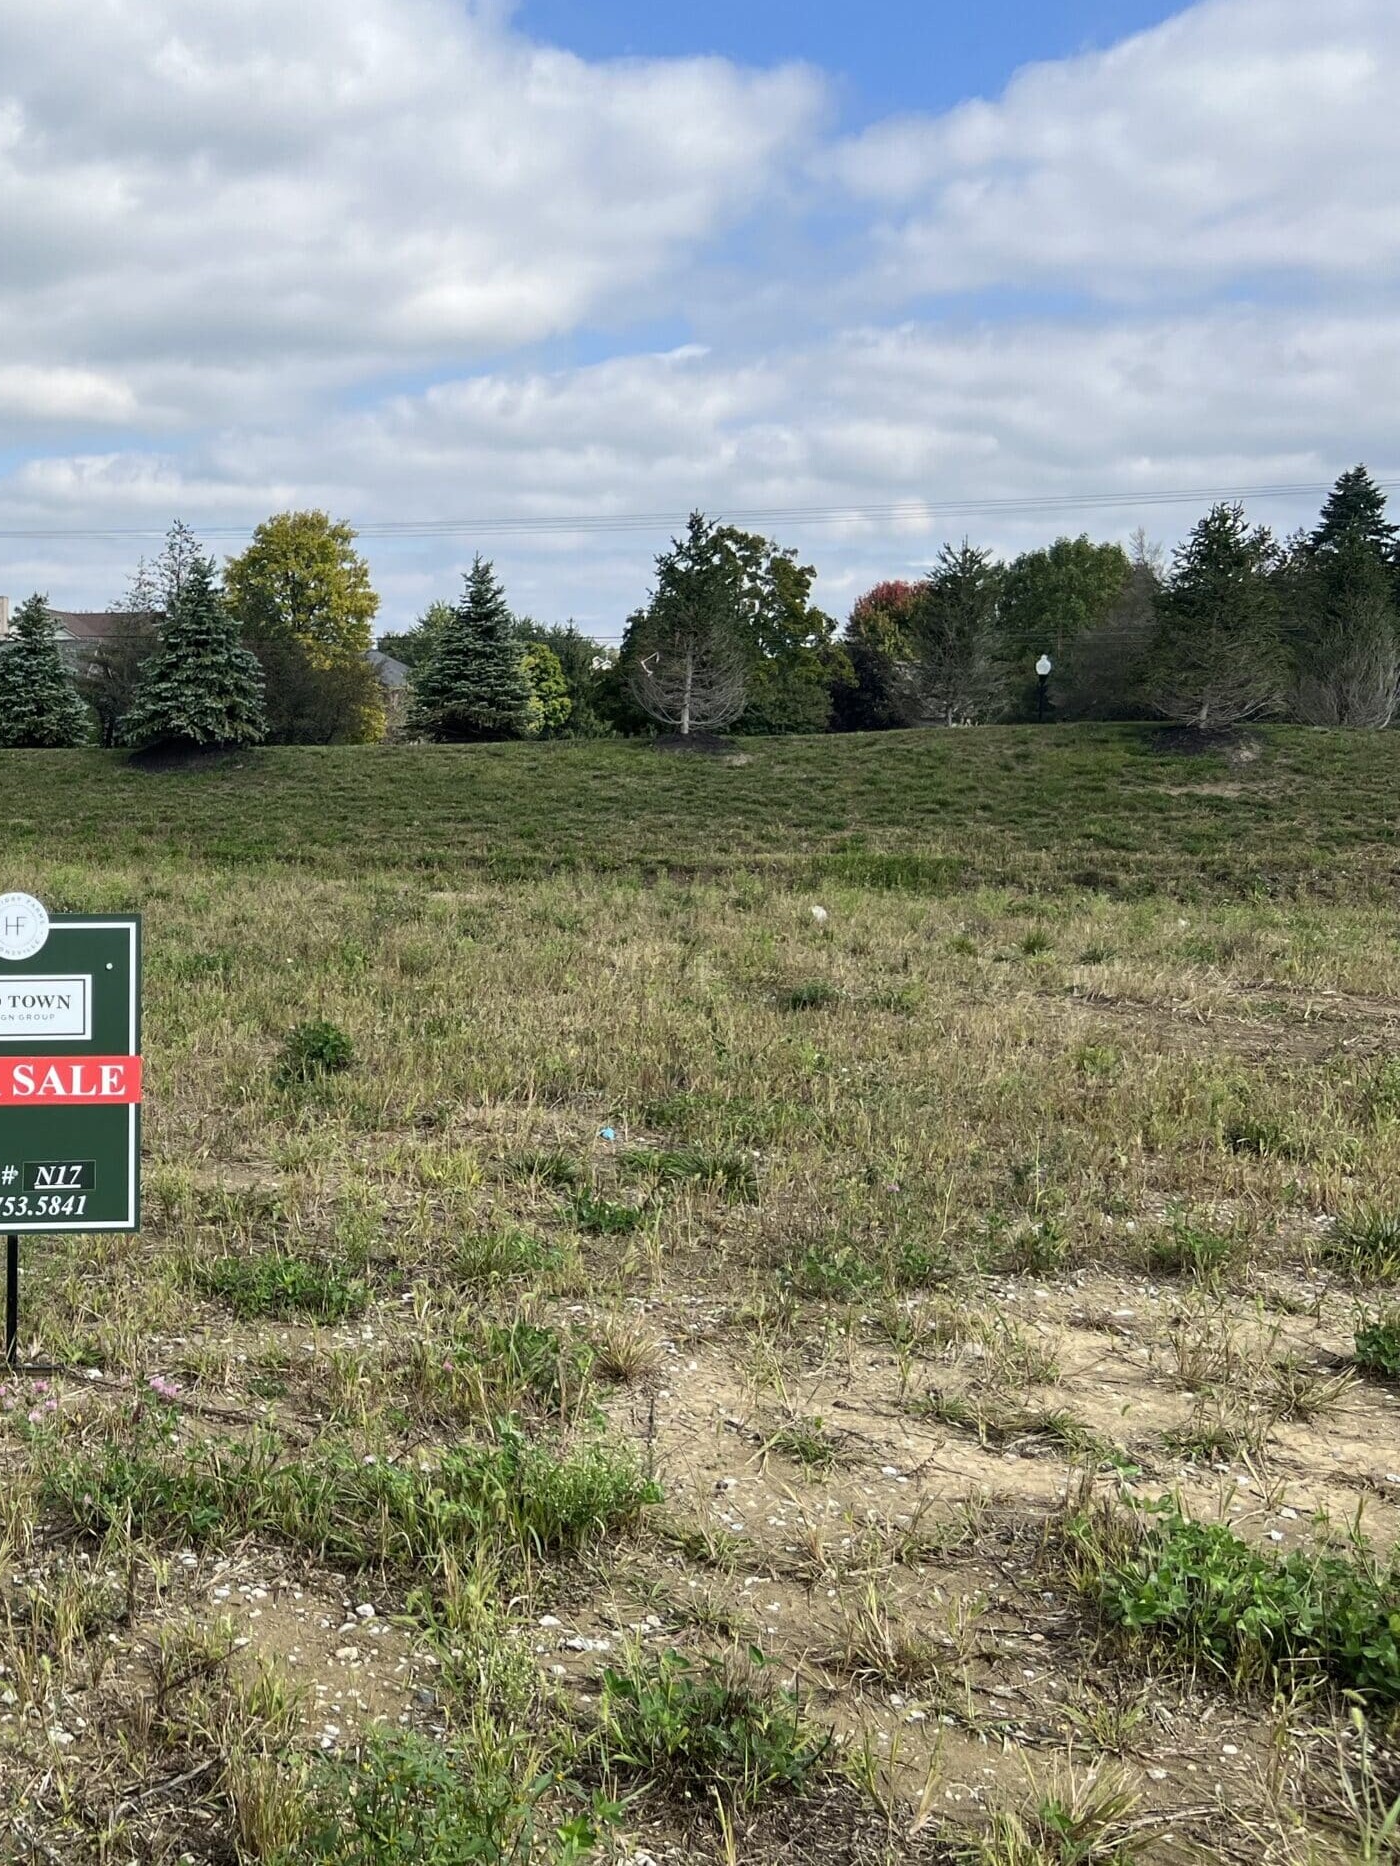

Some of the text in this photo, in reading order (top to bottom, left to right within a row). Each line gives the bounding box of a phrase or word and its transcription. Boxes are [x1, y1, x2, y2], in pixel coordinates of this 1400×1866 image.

[8, 994, 71, 1010] TOWN
[18, 1013, 55, 1021] GROUP
[12, 1064, 126, 1097] SALE
[1, 1164, 16, 1185] #
[34, 1165, 82, 1188] N17
